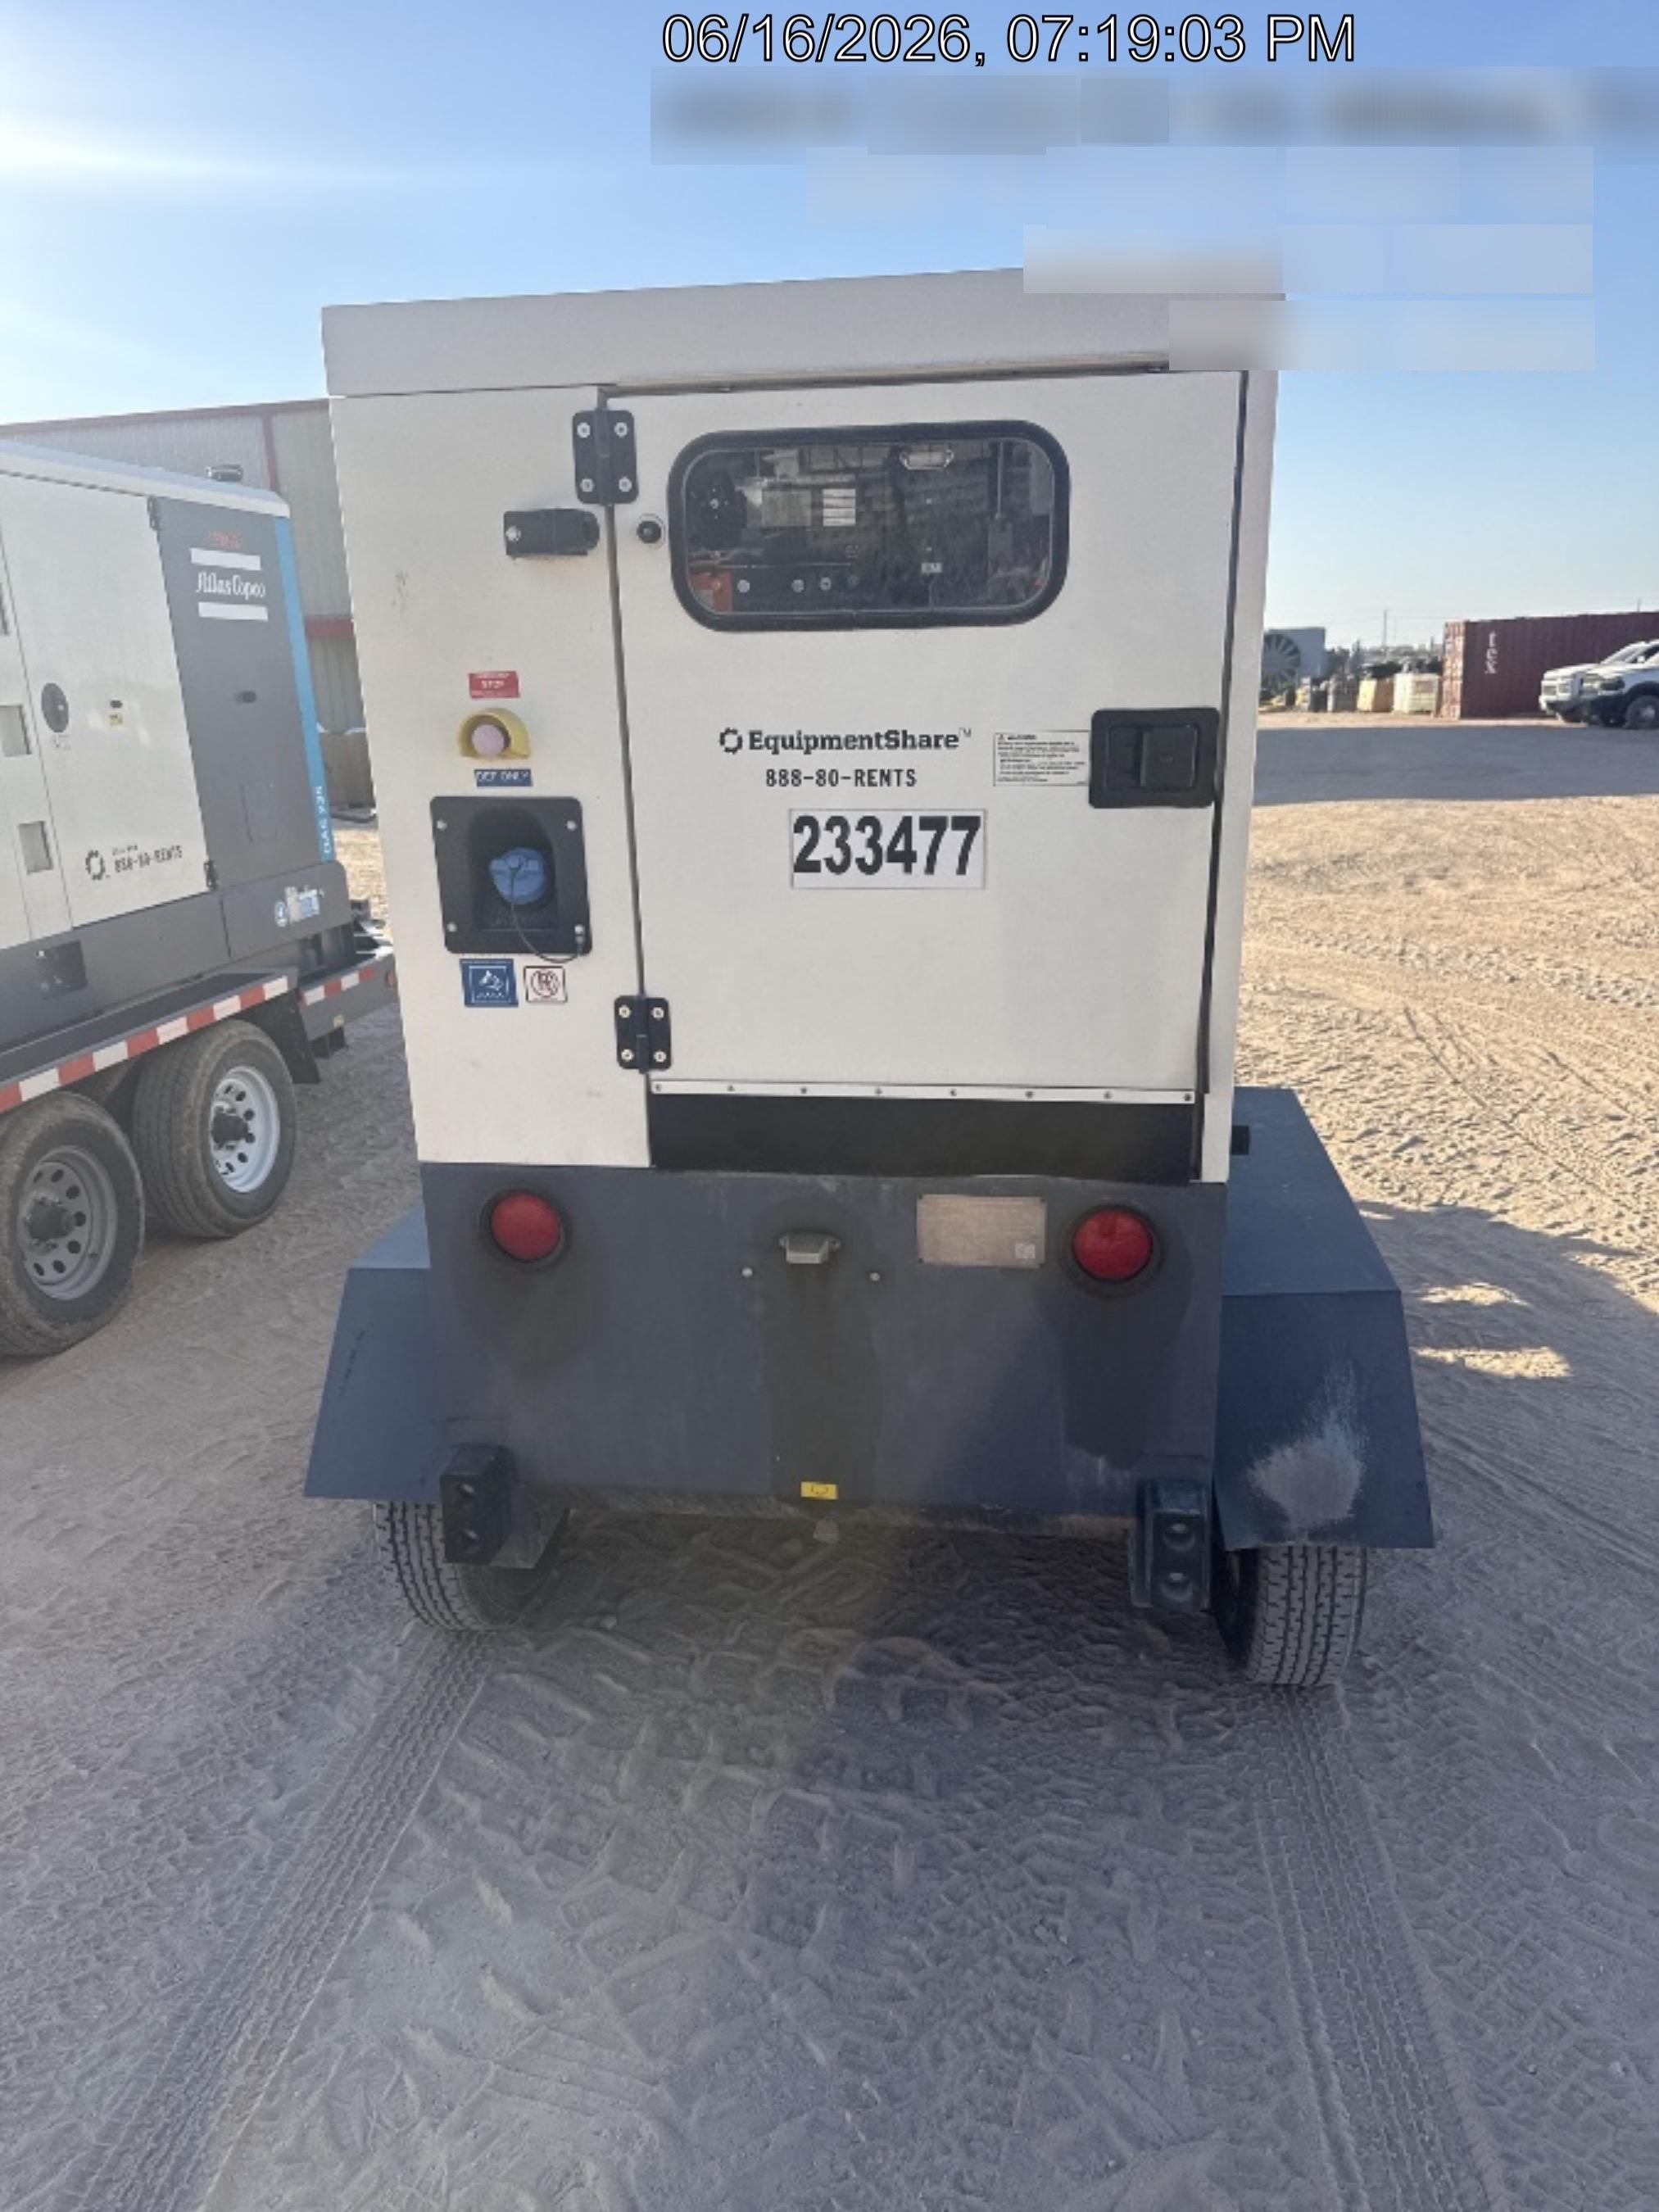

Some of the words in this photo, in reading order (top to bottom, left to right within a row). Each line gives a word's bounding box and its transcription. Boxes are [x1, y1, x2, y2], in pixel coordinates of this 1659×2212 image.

[748, 729, 959, 755] EquipmentShare
[765, 768, 918, 787] 888-80-RENTS
[792, 815, 981, 876] 233477
